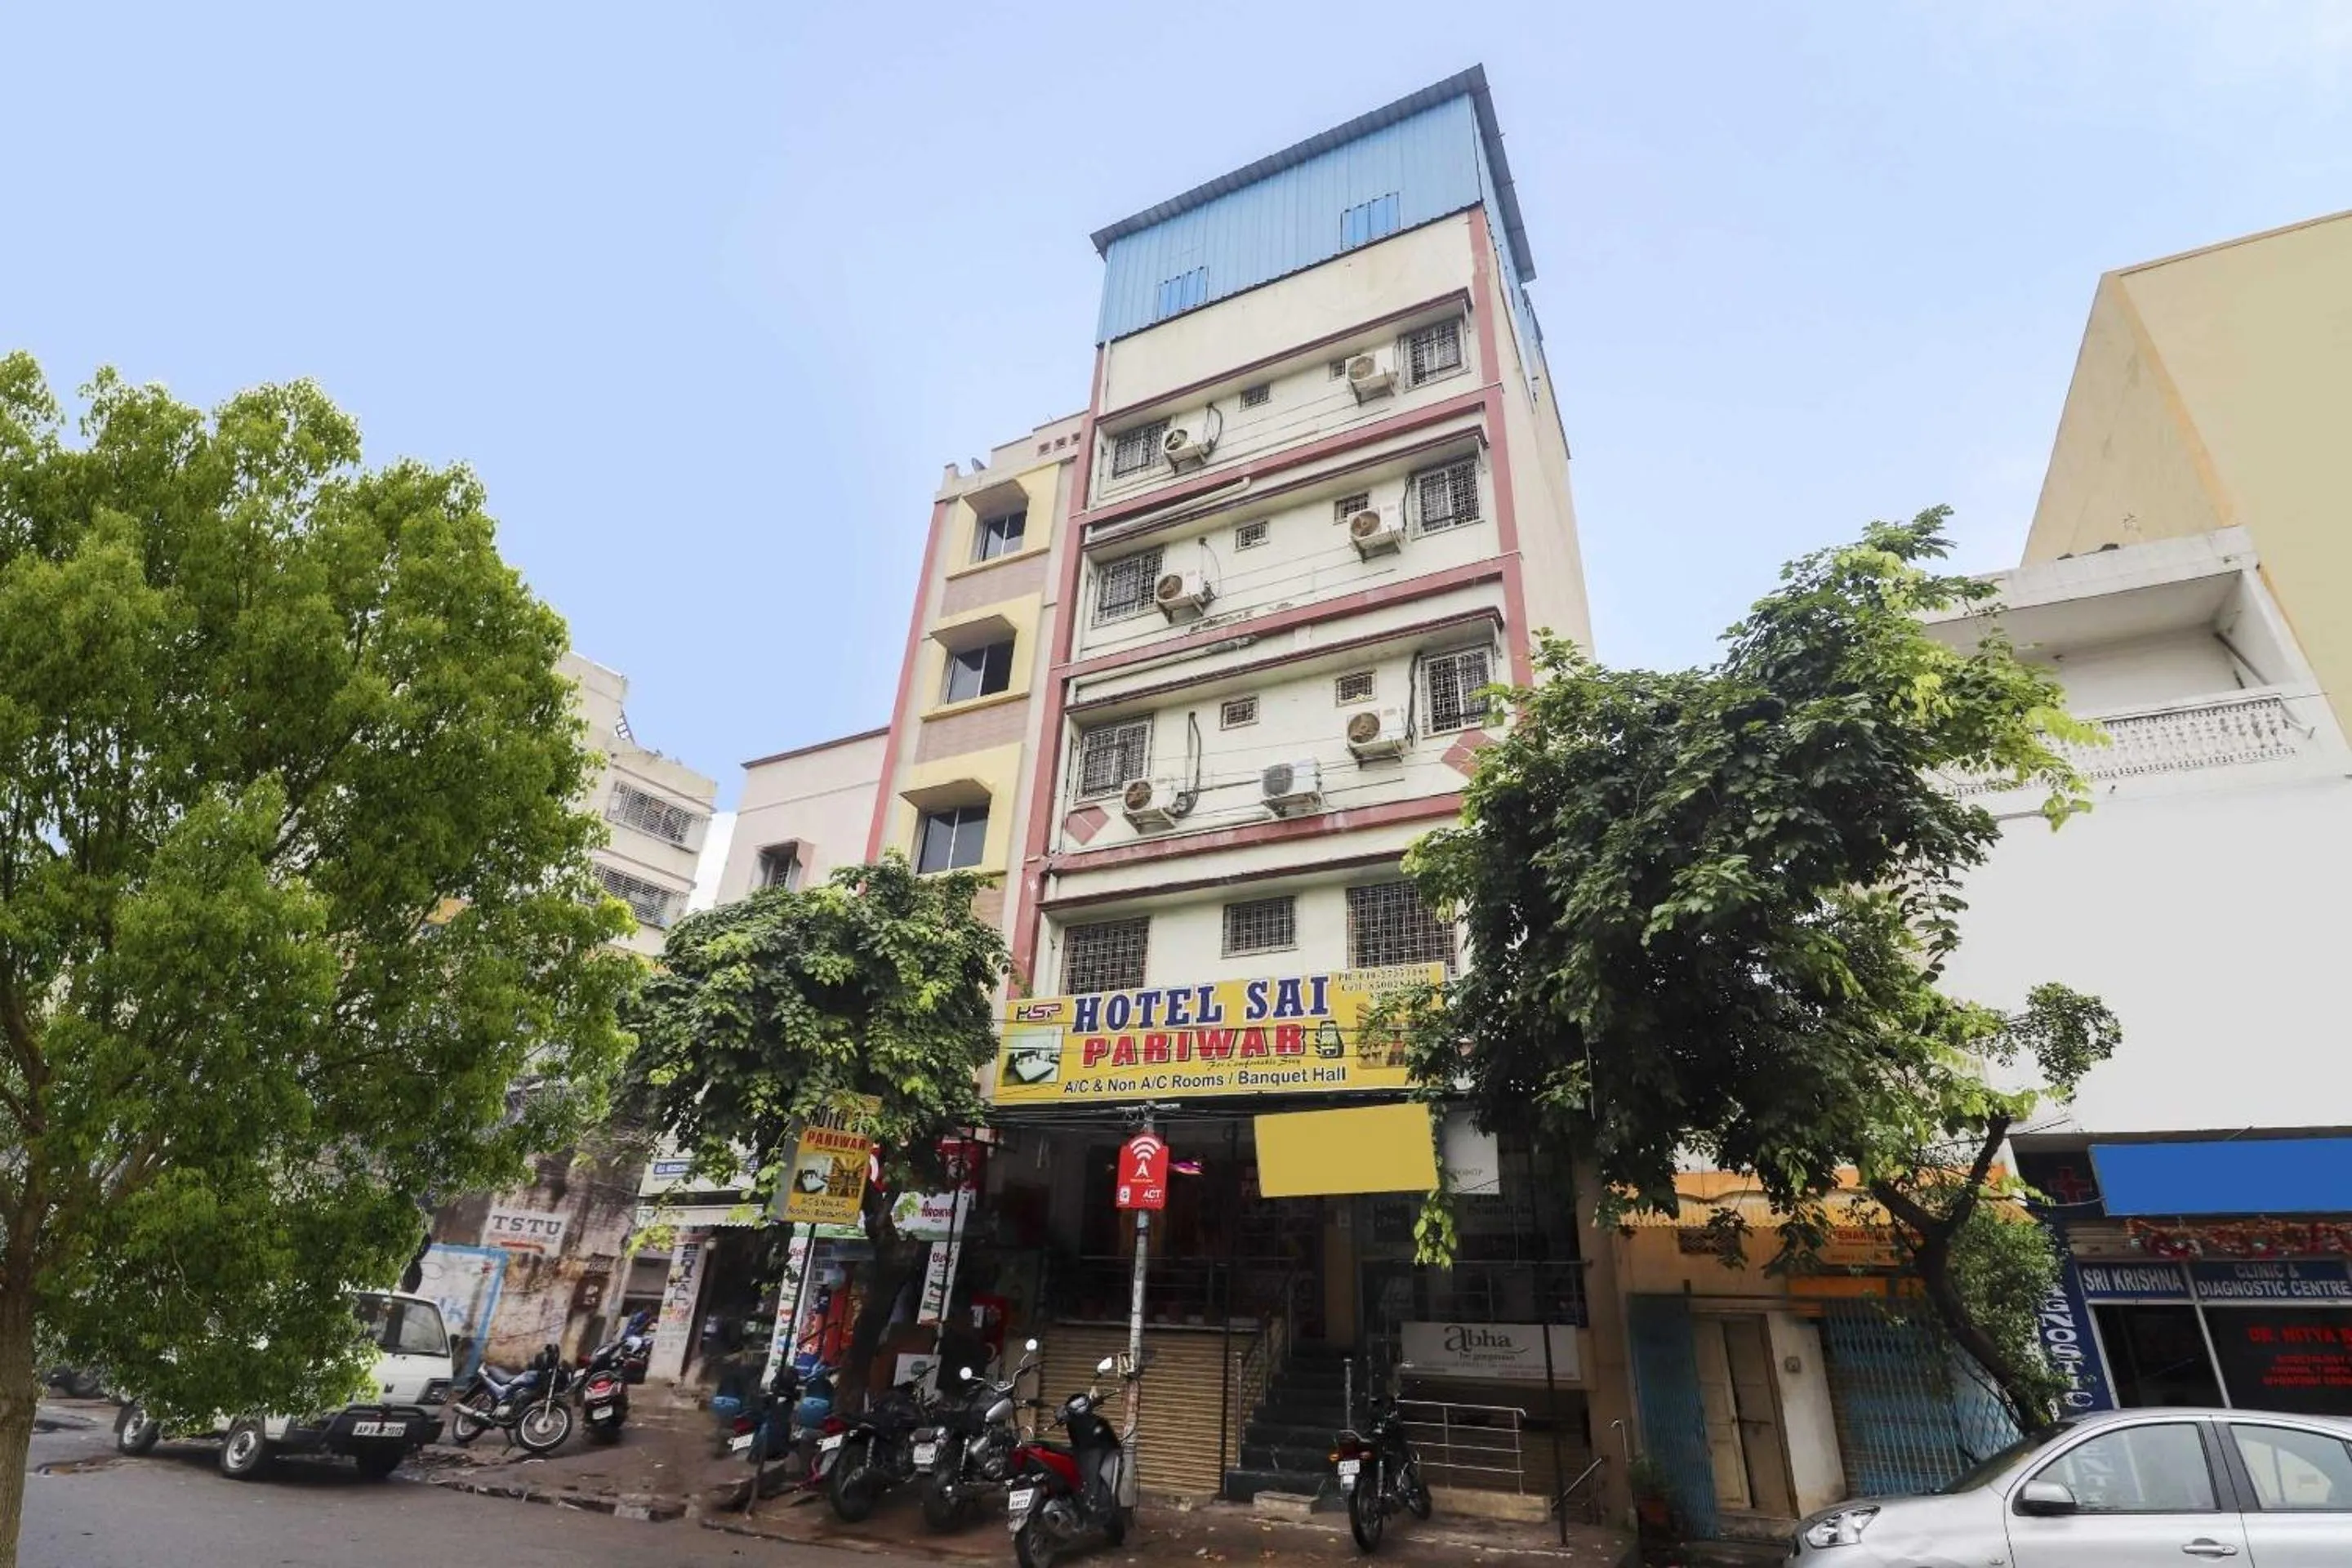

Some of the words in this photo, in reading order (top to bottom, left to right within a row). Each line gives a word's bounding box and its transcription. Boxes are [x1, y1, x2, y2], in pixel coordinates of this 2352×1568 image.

[1071, 985, 1223, 1033] HOTEL
[1245, 976, 1329, 1020] SAI
[1081, 1023, 1306, 1068] PARIWAR
[1064, 1080, 1089, 1094] A/C
[1093, 1080, 1102, 1092] &
[1107, 1078, 1136, 1092] Non
[1141, 1075, 1168, 1089] A/C
[1172, 1073, 1223, 1087] Rooms
[1238, 1068, 1308, 1085] Banquet
[1312, 1066, 1346, 1081] Hall
[1143, 1189, 1162, 1199] ACT
[492, 1214, 562, 1236] TSTU
[2083, 1267, 2111, 1291] SRI
[2112, 1267, 2185, 1291] KRISHNA
[2234, 1263, 2284, 1279] CLINIC
[2288, 1263, 2300, 1279] &
[2196, 1280, 2287, 1296] DIAGNOSTIC
[2290, 1280, 2352, 1296] CENTRE
